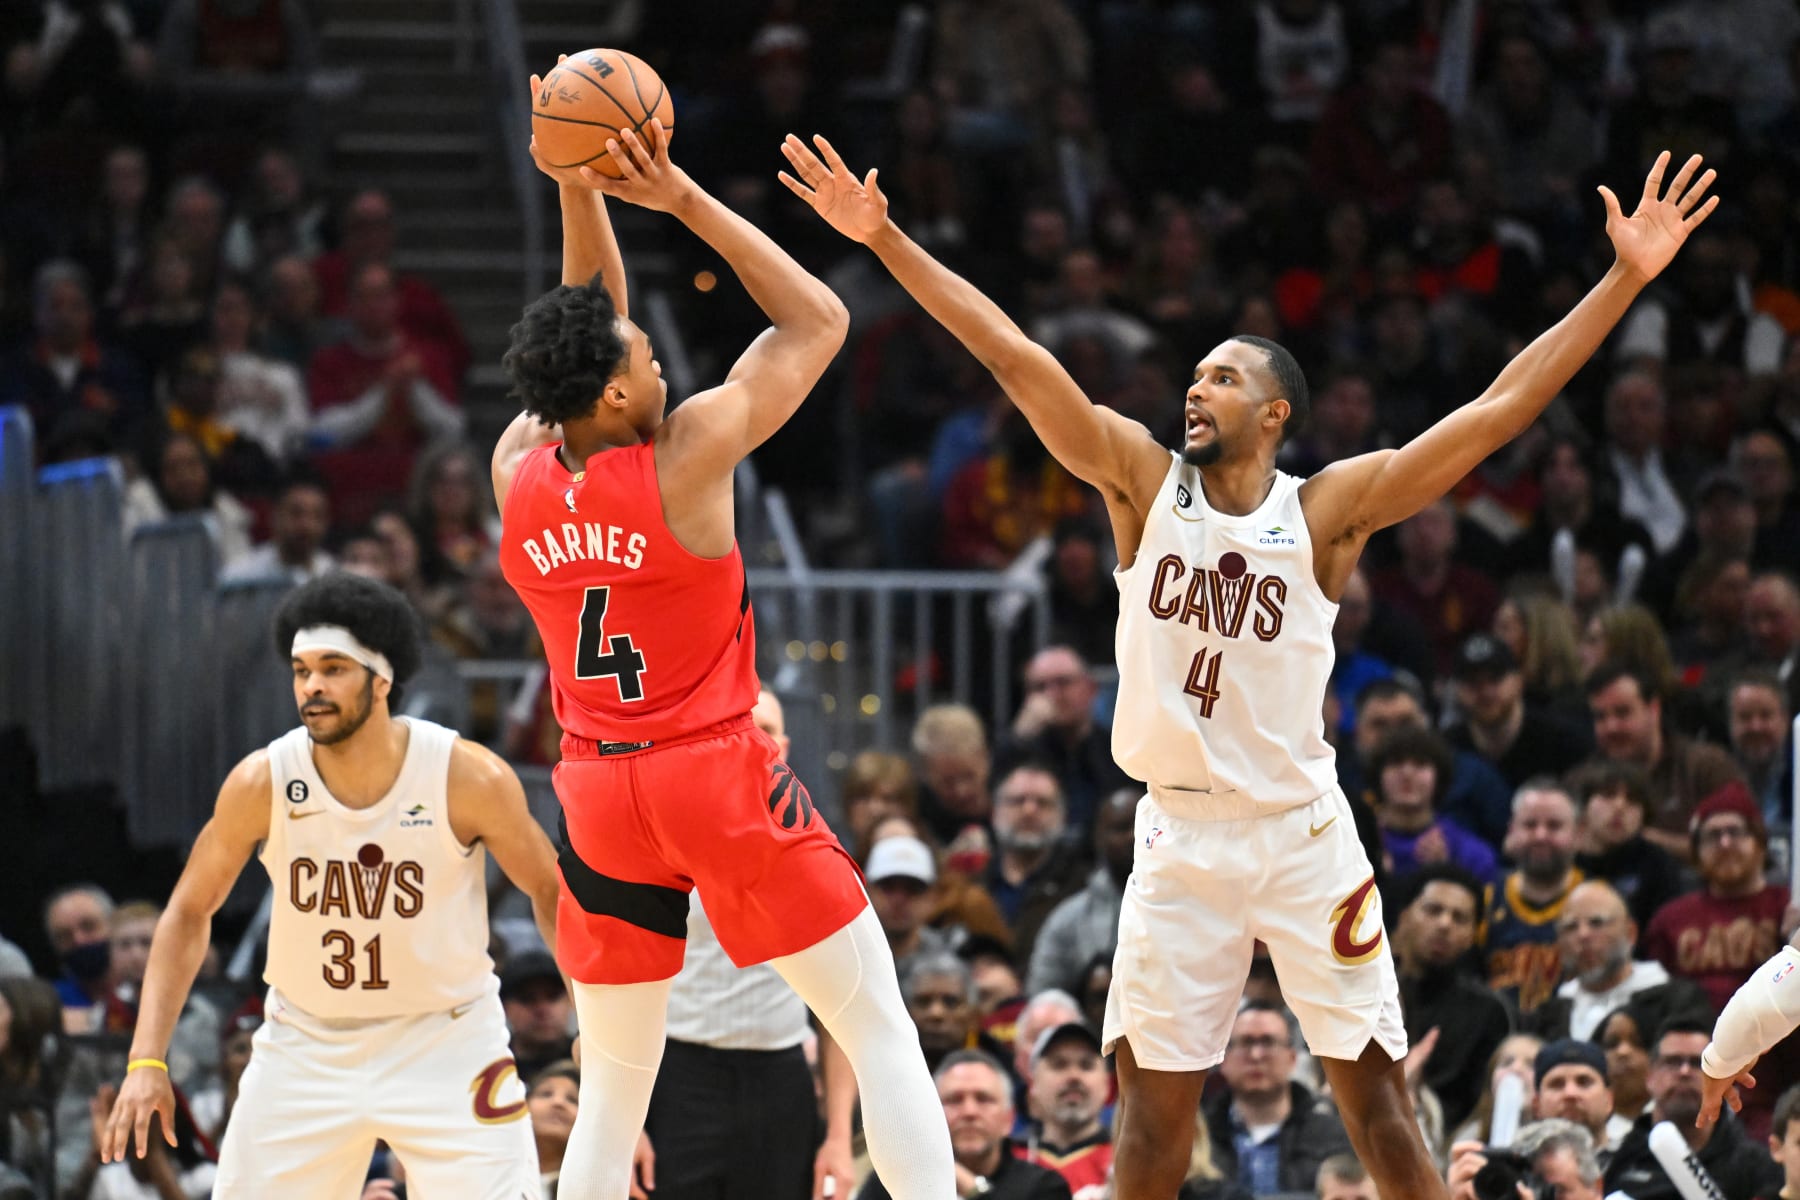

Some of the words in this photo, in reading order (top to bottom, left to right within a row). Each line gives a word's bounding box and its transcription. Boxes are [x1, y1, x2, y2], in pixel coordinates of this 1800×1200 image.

[1177, 490, 1188, 506] 6
[522, 523, 647, 576] BARNES
[1259, 537, 1295, 545] CLIFFS
[1149, 553, 1288, 642] CAVS
[575, 585, 647, 703] 4
[1183, 646, 1223, 719] 4
[290, 783, 305, 798] 6
[290, 857, 423, 920] CAVS
[322, 929, 389, 990] 31
